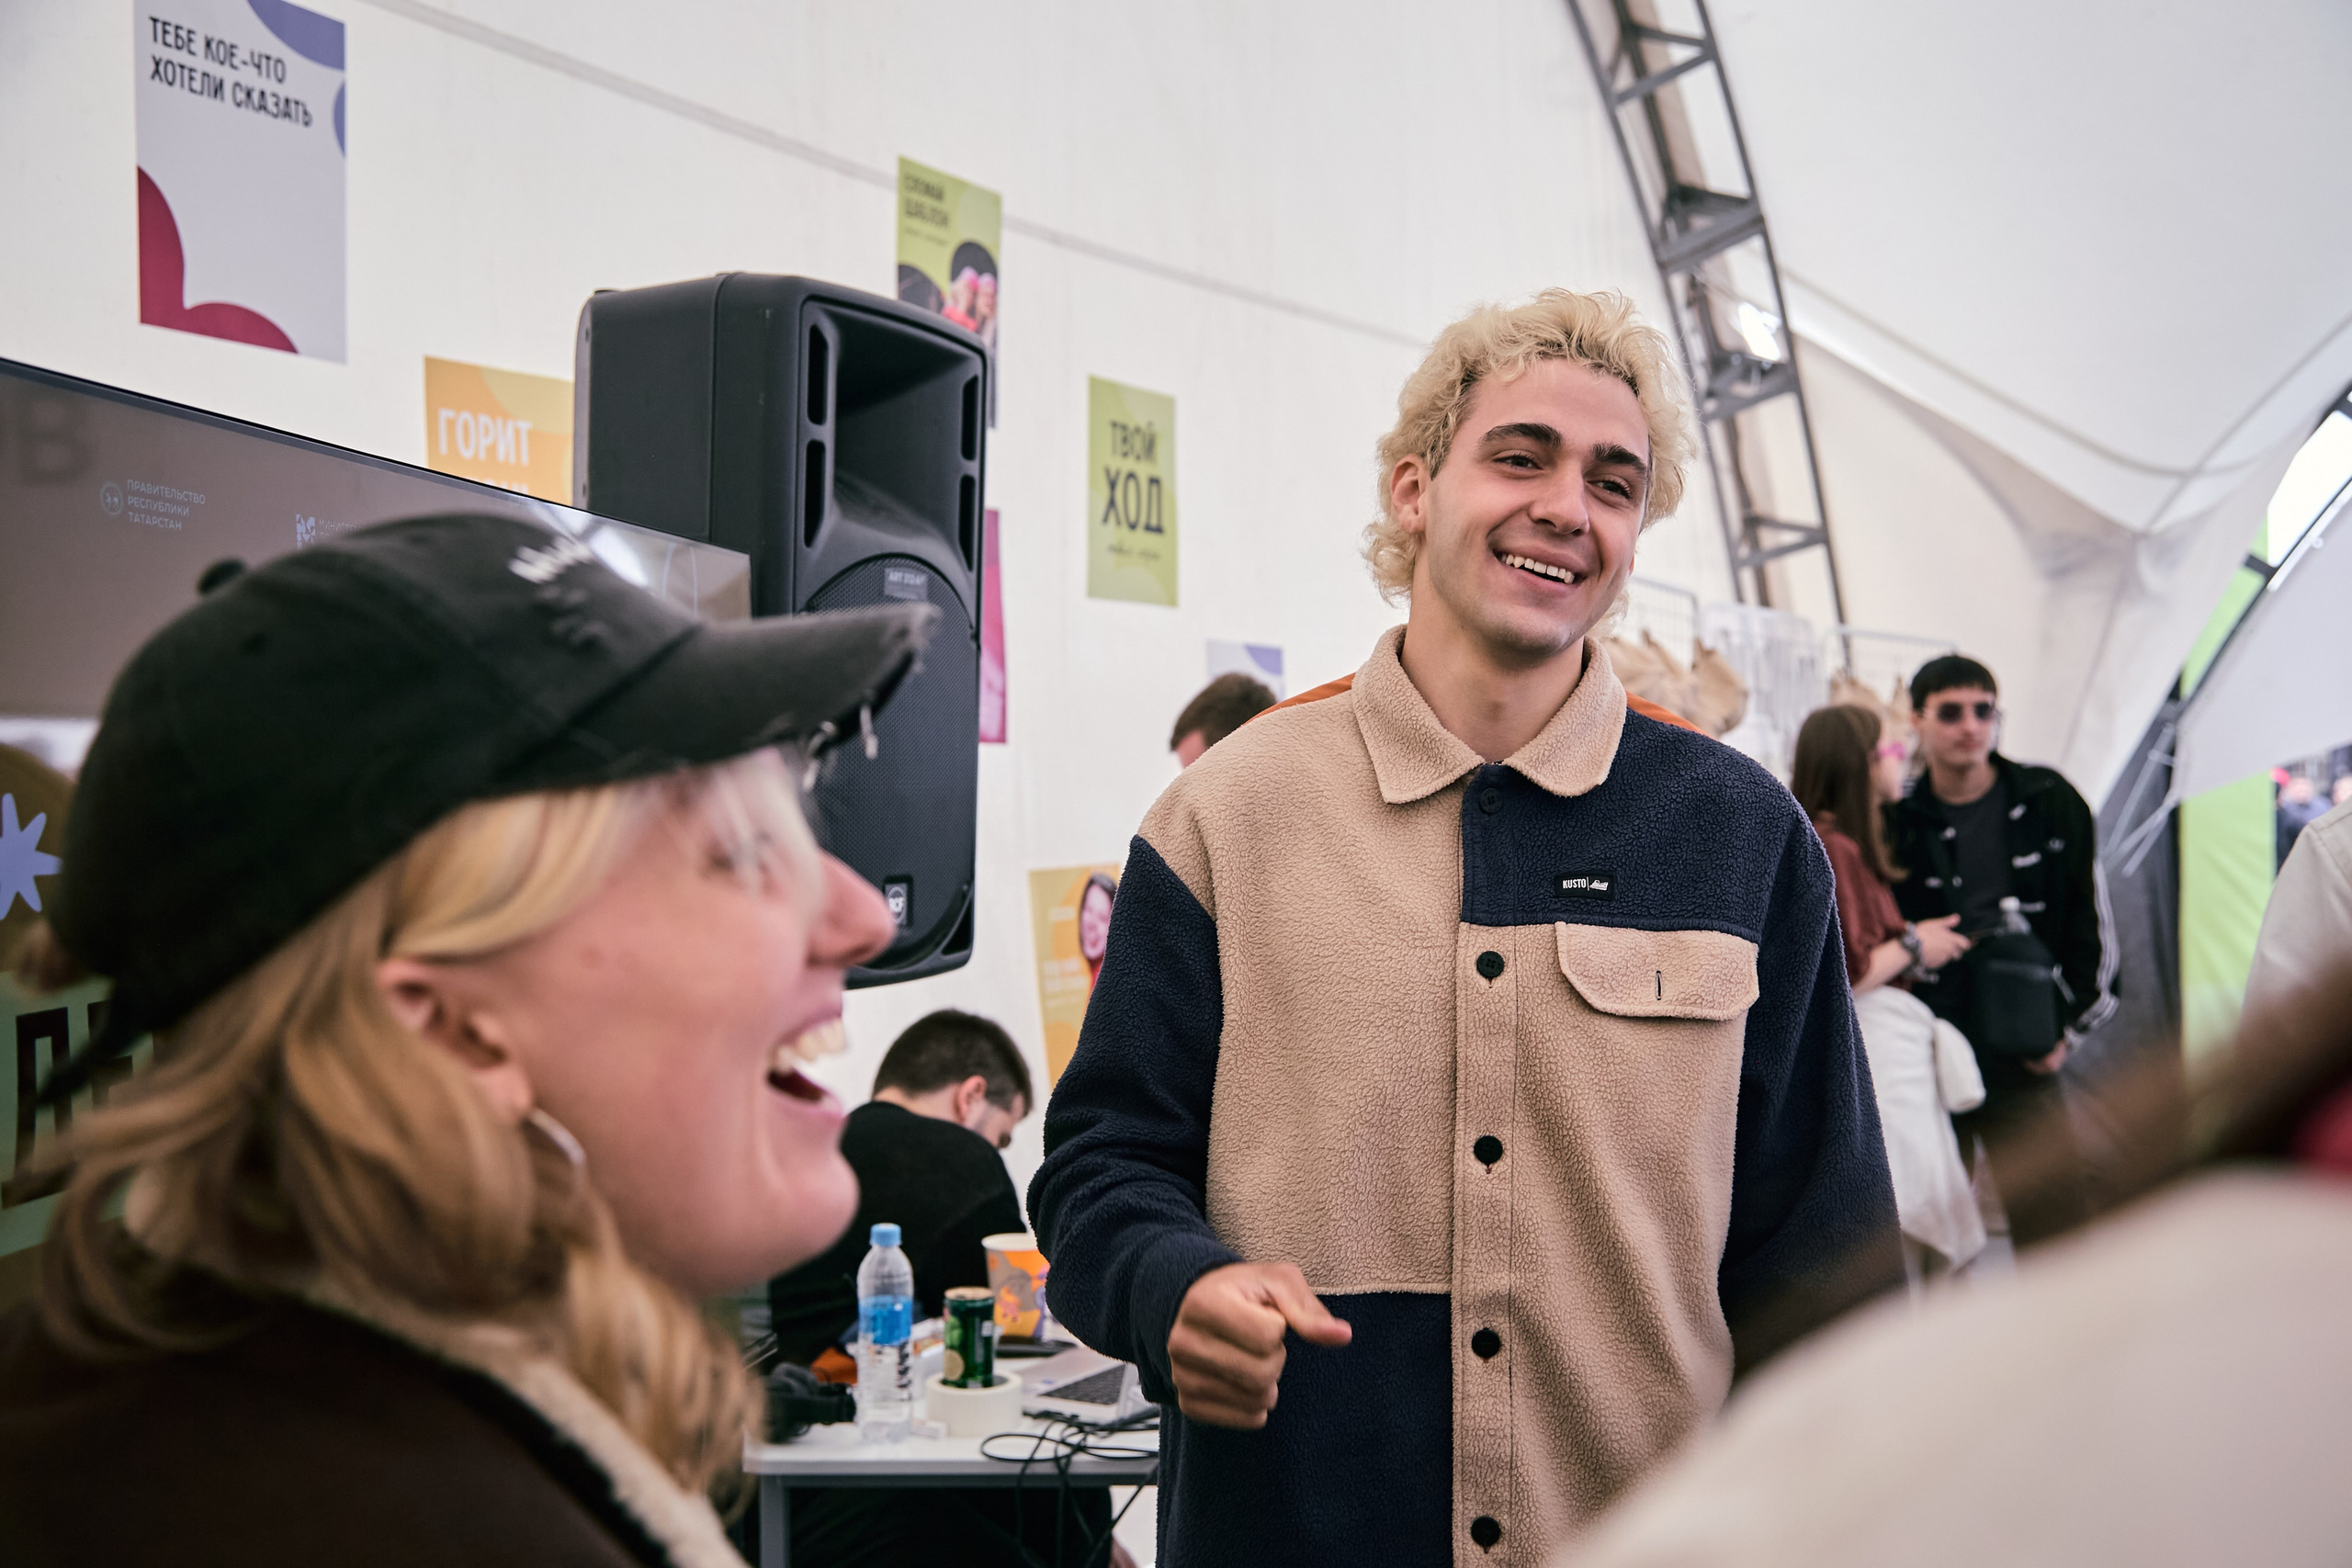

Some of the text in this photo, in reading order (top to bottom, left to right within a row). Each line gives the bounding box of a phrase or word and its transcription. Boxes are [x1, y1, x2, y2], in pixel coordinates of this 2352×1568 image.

[149, 16, 287, 85] ТЕБЕ КОЕ-ЧТО
[151, 54, 313, 128] ХОТЕЛИ СКАЗАТЬ
[437, 407, 533, 466] ГОРИТ
[1110, 419, 1158, 464] ТВОЙ
[126, 479, 206, 505] ПРАВИТЕЛЬСТВО
[127, 495, 190, 516] РЕСПУБЛИКИ
[1101, 465, 1165, 535] ХОД
[128, 511, 182, 531] ТАТАРСТАН
[1562, 878, 1587, 889] KUSTO
